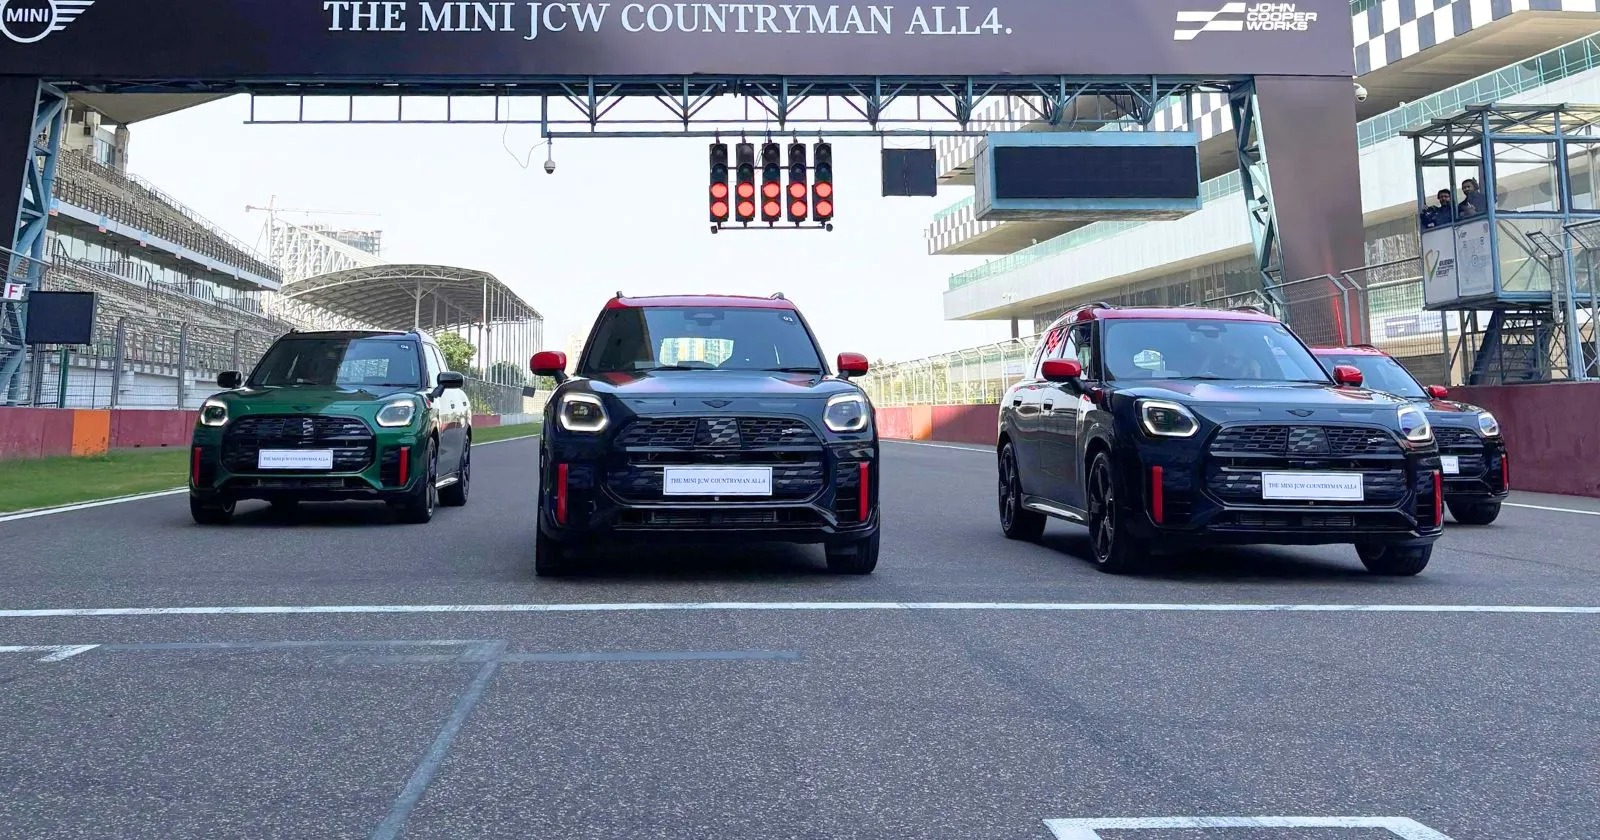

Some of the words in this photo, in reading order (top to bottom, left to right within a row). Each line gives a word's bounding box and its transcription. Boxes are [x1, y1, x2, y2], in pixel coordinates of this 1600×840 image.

[1247, 2, 1296, 12] JOHN
[6, 8, 49, 22] MINI
[323, 1, 406, 31] THE
[418, 2, 515, 31] MINI
[523, 2, 610, 40] JCW
[621, 3, 893, 34] COUNTRYMAN
[905, 6, 1013, 35] ALL4.
[1246, 12, 1318, 21] COOPER
[1246, 21, 1308, 31] WORKS
[8, 284, 20, 299] F
